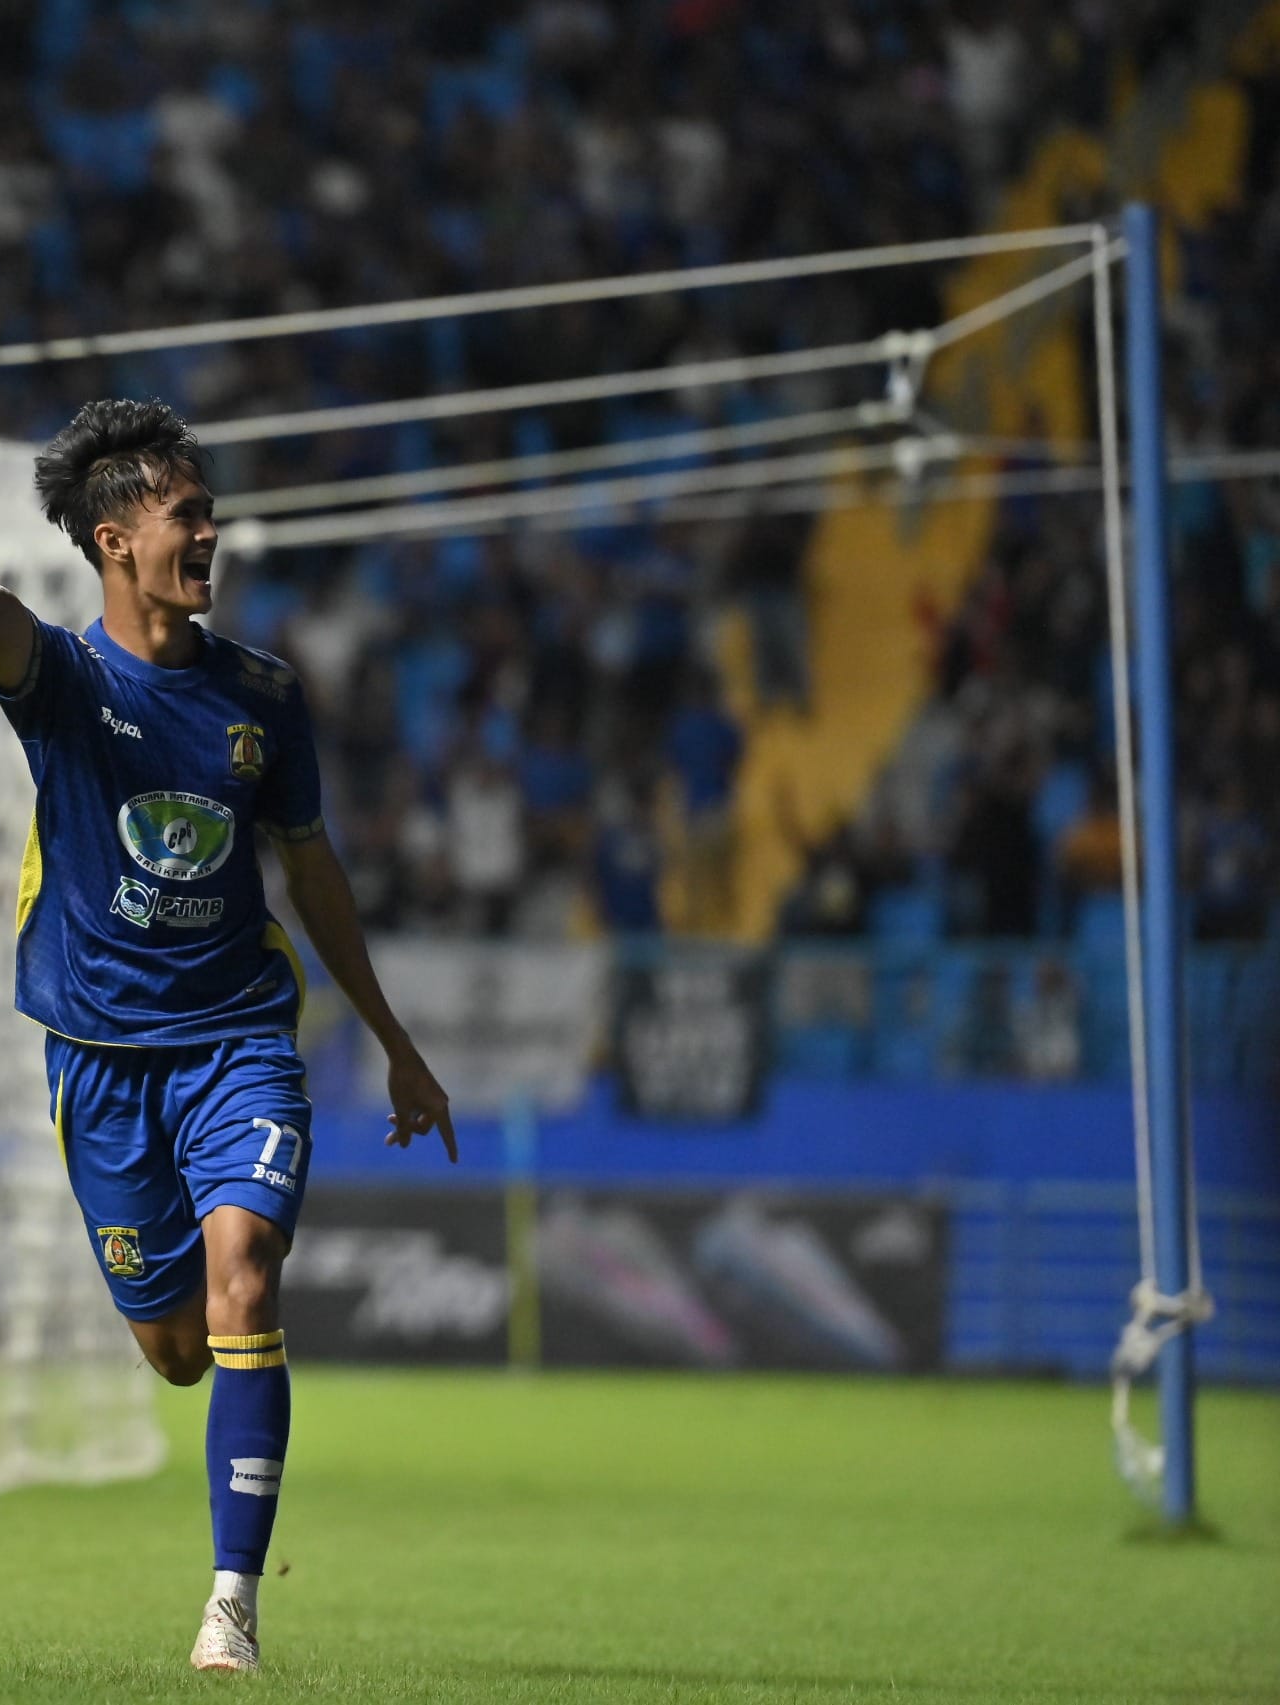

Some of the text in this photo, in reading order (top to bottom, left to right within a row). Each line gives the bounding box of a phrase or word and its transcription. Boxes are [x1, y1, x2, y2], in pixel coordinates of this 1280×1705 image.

[136, 854, 211, 879] BALIKPAPAN
[157, 895, 224, 918] PTMB
[252, 1117, 302, 1176] 77
